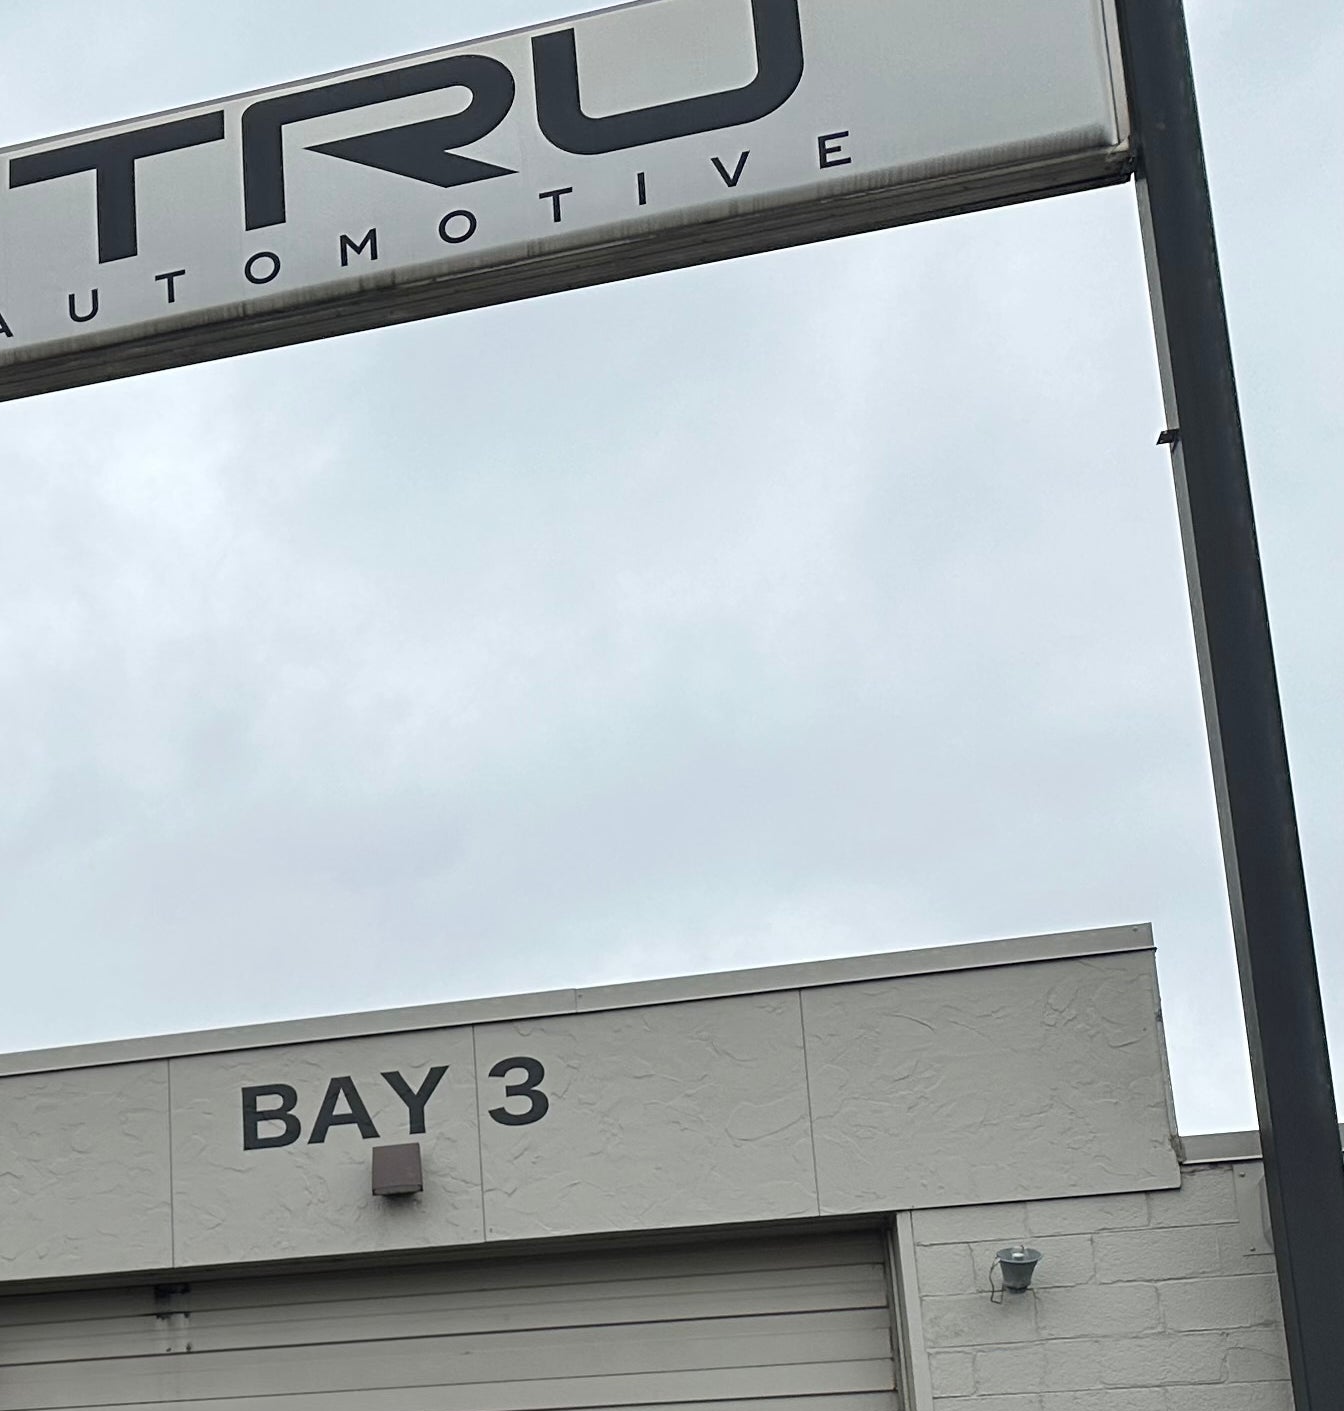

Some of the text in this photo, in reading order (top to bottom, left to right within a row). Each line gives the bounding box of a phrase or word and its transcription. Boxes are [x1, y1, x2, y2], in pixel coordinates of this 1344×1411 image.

[9, 0, 804, 265] TRU
[241, 1056, 550, 1151] BAY 3
